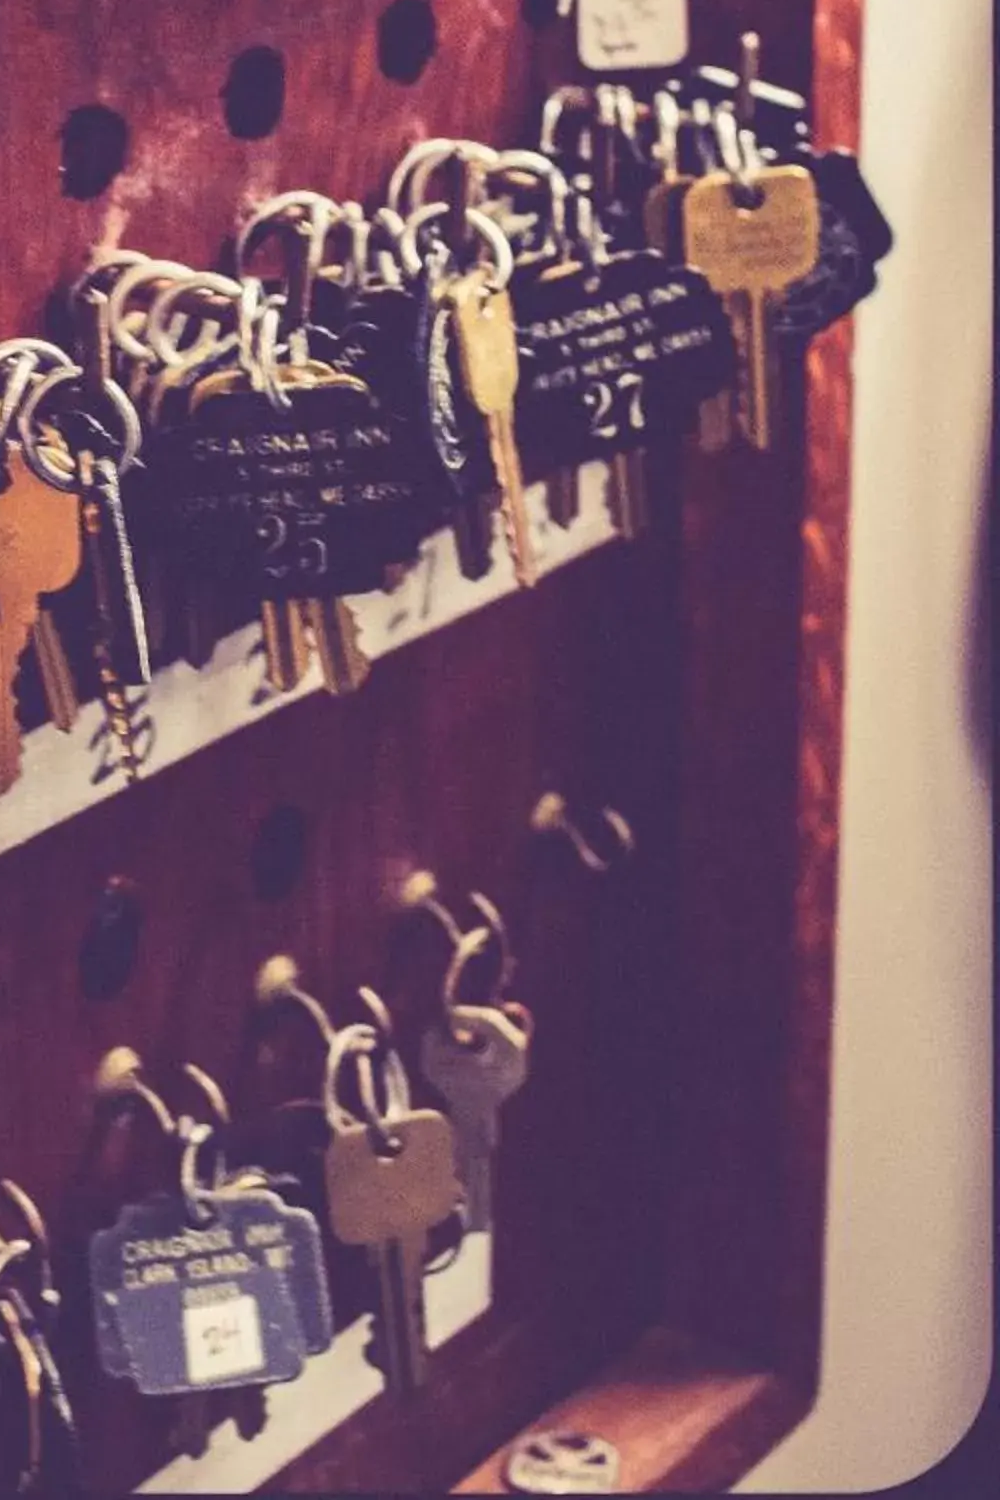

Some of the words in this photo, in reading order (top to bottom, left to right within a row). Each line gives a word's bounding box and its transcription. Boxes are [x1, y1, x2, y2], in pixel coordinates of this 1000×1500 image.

[648, 282, 689, 306] INN
[583, 372, 645, 439] 27
[256, 512, 328, 579] 25
